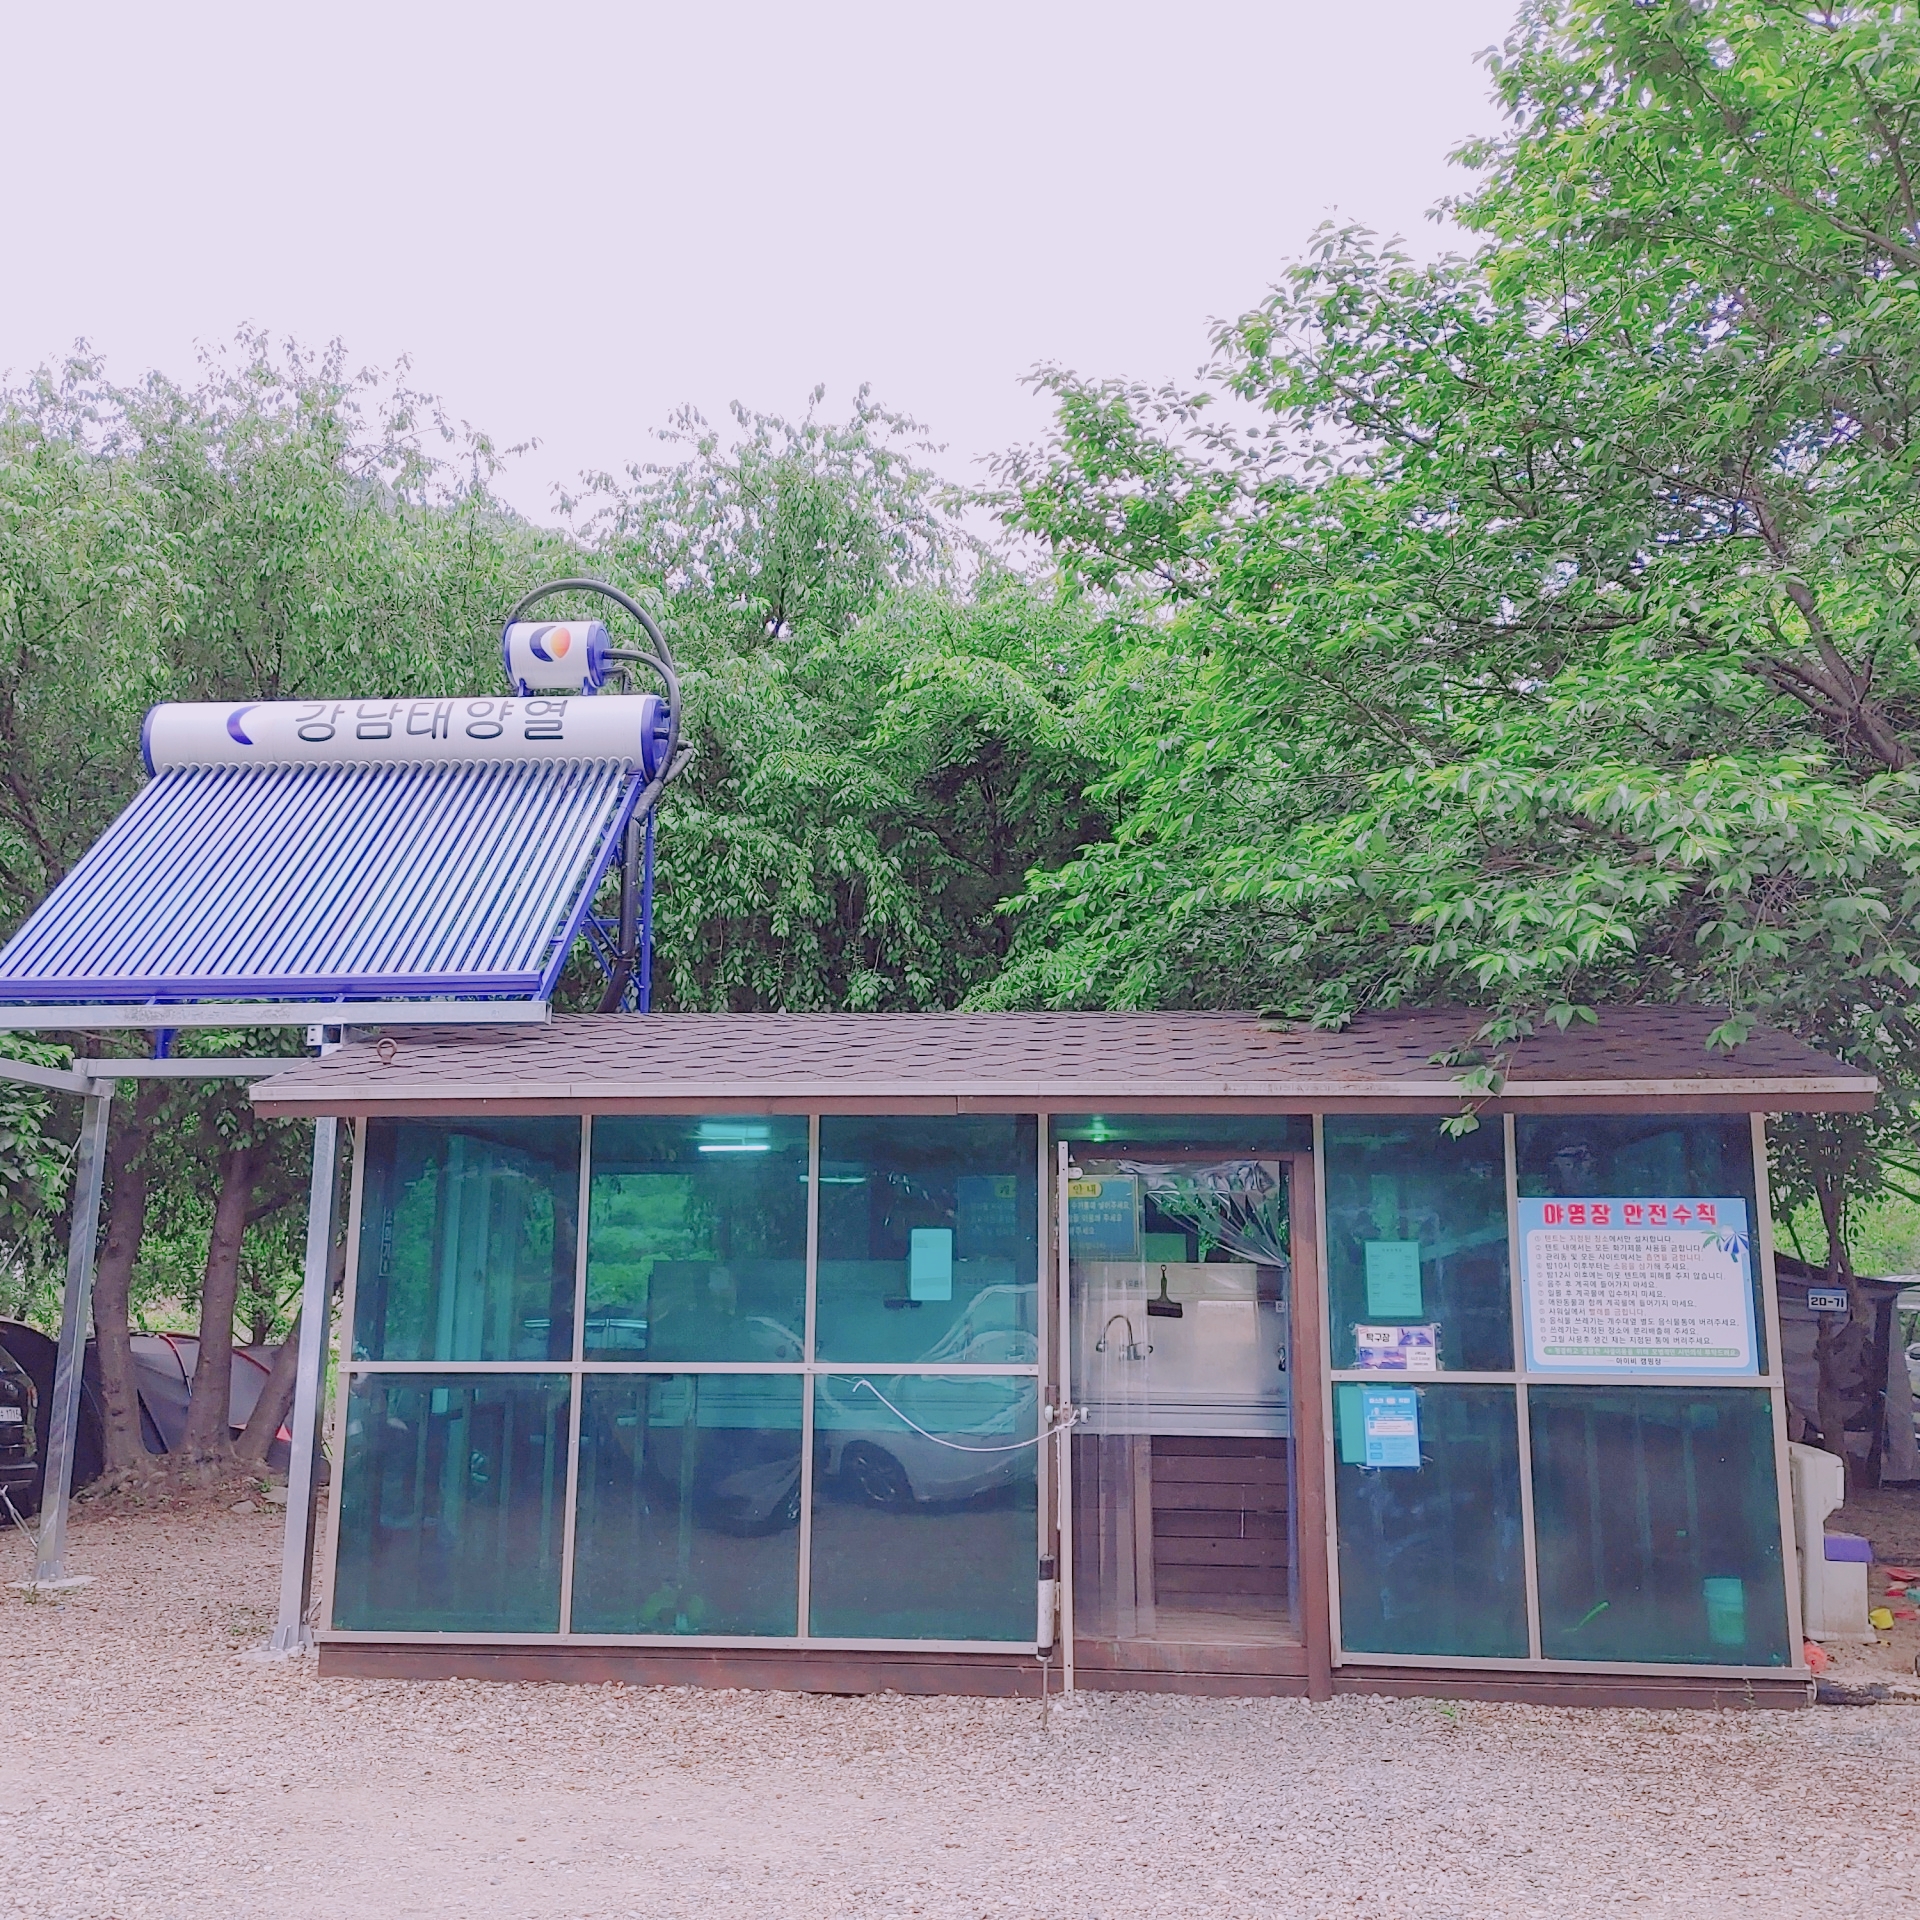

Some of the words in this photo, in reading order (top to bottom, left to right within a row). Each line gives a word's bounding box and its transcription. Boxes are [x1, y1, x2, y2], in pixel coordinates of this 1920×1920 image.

[295, 699, 568, 742] 강남태양열
[1544, 1203, 1611, 1226] 야영장
[1623, 1204, 1717, 1226] 안전수칙
[1594, 1235, 1631, 1243] 장소에서만
[1545, 1244, 1559, 1252] 텐트
[1563, 1244, 1592, 1252] 내에서는
[1595, 1244, 1609, 1252] 모든
[1546, 1262, 1570, 1270] 밤10시
[1574, 1262, 1610, 1270] 이후부터는
[1650, 1272, 1671, 1280] 피해를
[1547, 1280, 1561, 1288] 음주
[1575, 1280, 1597, 1288] 계곡에
[1608, 1290, 1637, 1298] 입수하지
[1606, 1299, 1635, 1307] 계곡물에
[1811, 1297, 1844, 1307] 20-71
[1549, 1308, 1585, 1316] 샤워실에서
[1659, 1318, 1696, 1326] 음식물통에
[1366, 1333, 1390, 1342] 탁구장
[1594, 1336, 1608, 1344] 생긴
[1612, 1336, 1626, 1344] 재는
[1630, 1336, 1652, 1344] 지정된
